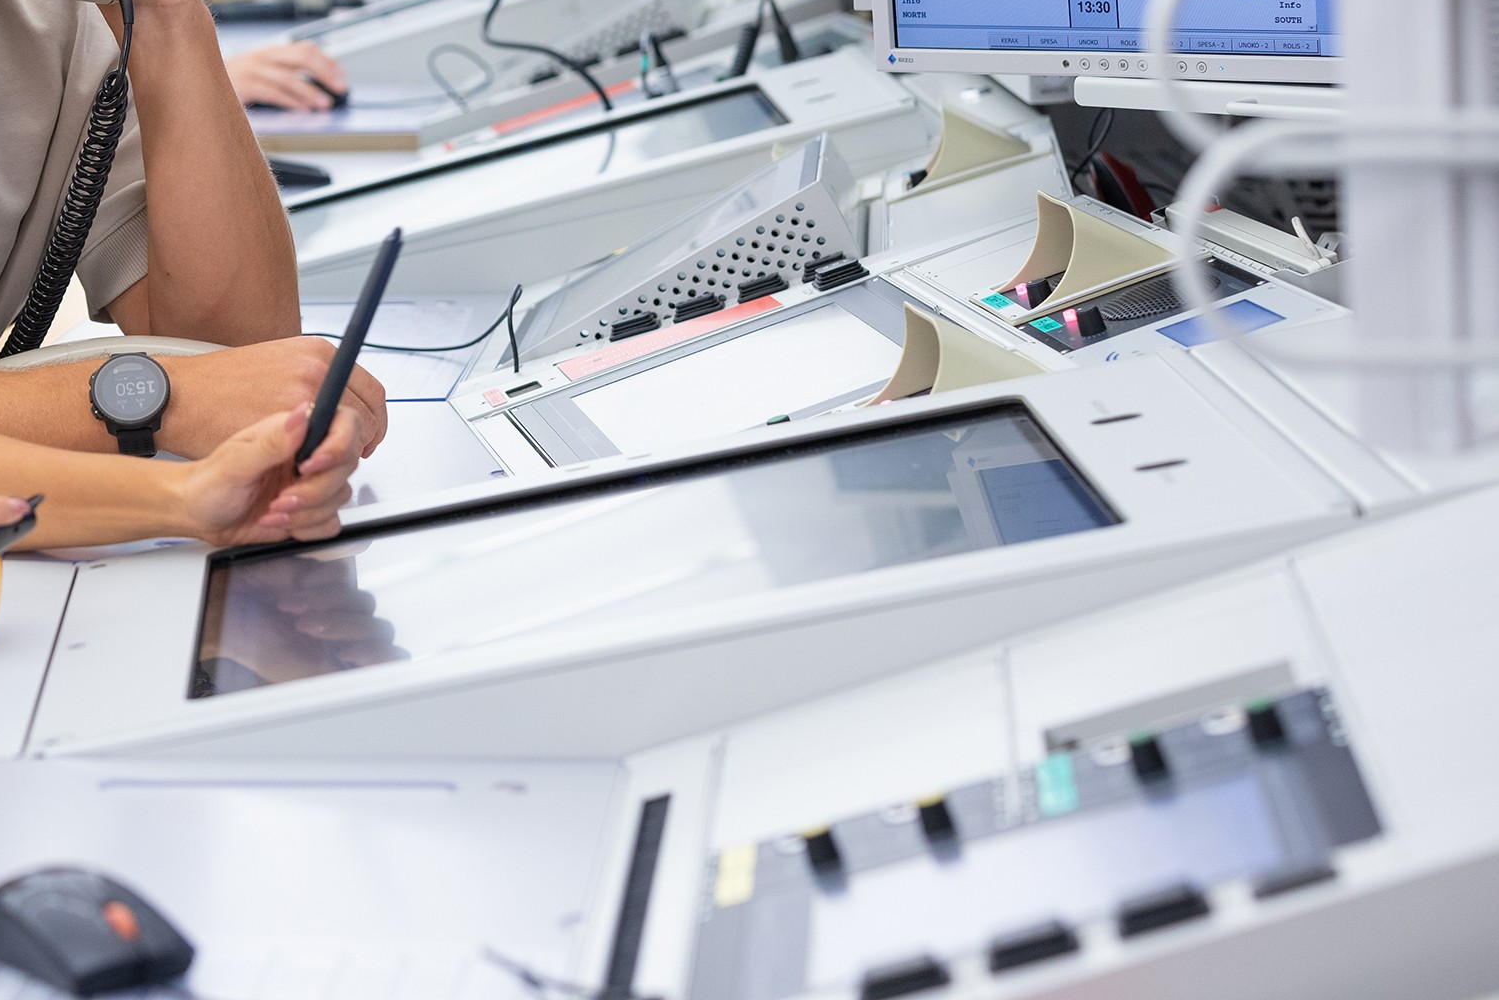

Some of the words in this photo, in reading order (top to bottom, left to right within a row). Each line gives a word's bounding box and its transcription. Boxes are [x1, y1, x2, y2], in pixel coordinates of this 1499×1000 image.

[1077, 1, 1110, 13] 13:30
[902, 11, 927, 19] NORTH
[1275, 16, 1302, 24] SOUTH
